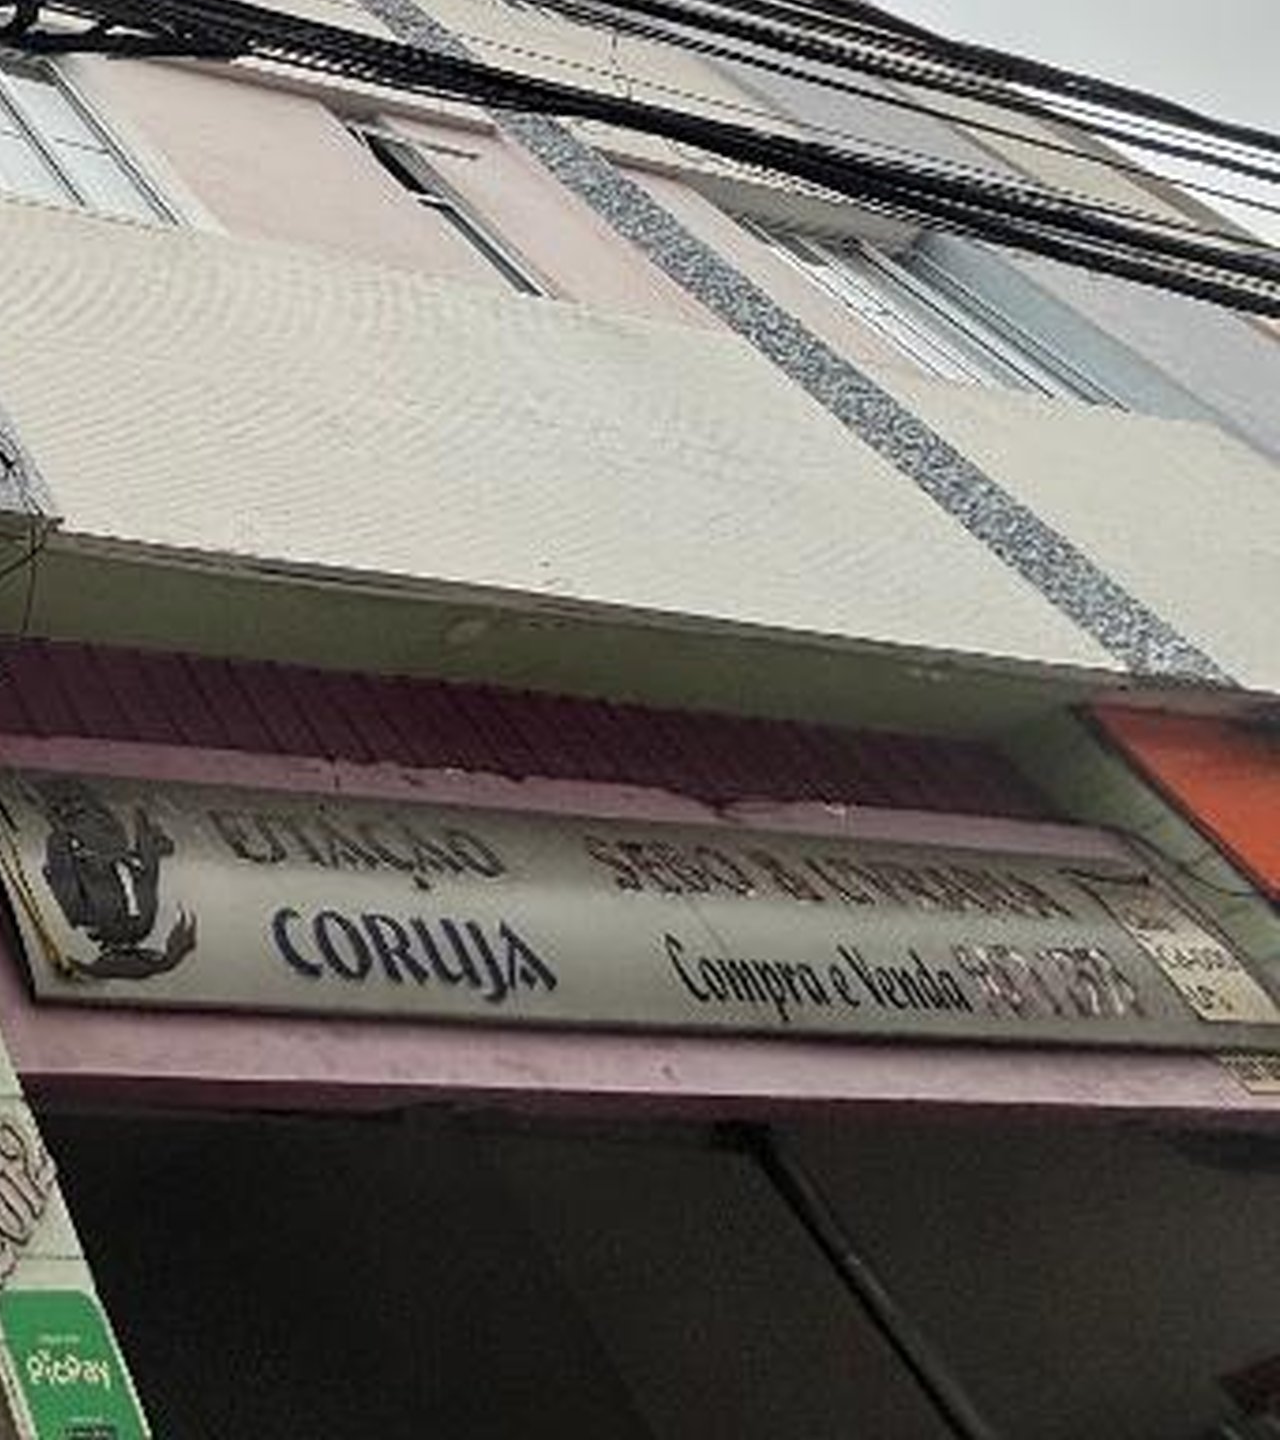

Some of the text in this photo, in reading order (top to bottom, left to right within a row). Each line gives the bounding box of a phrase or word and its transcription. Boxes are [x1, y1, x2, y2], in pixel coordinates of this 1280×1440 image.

[271, 906, 559, 1004] CORUJA
[662, 932, 827, 1022] Compra
[831, 970, 861, 1007] e
[837, 944, 973, 1014] Venda
